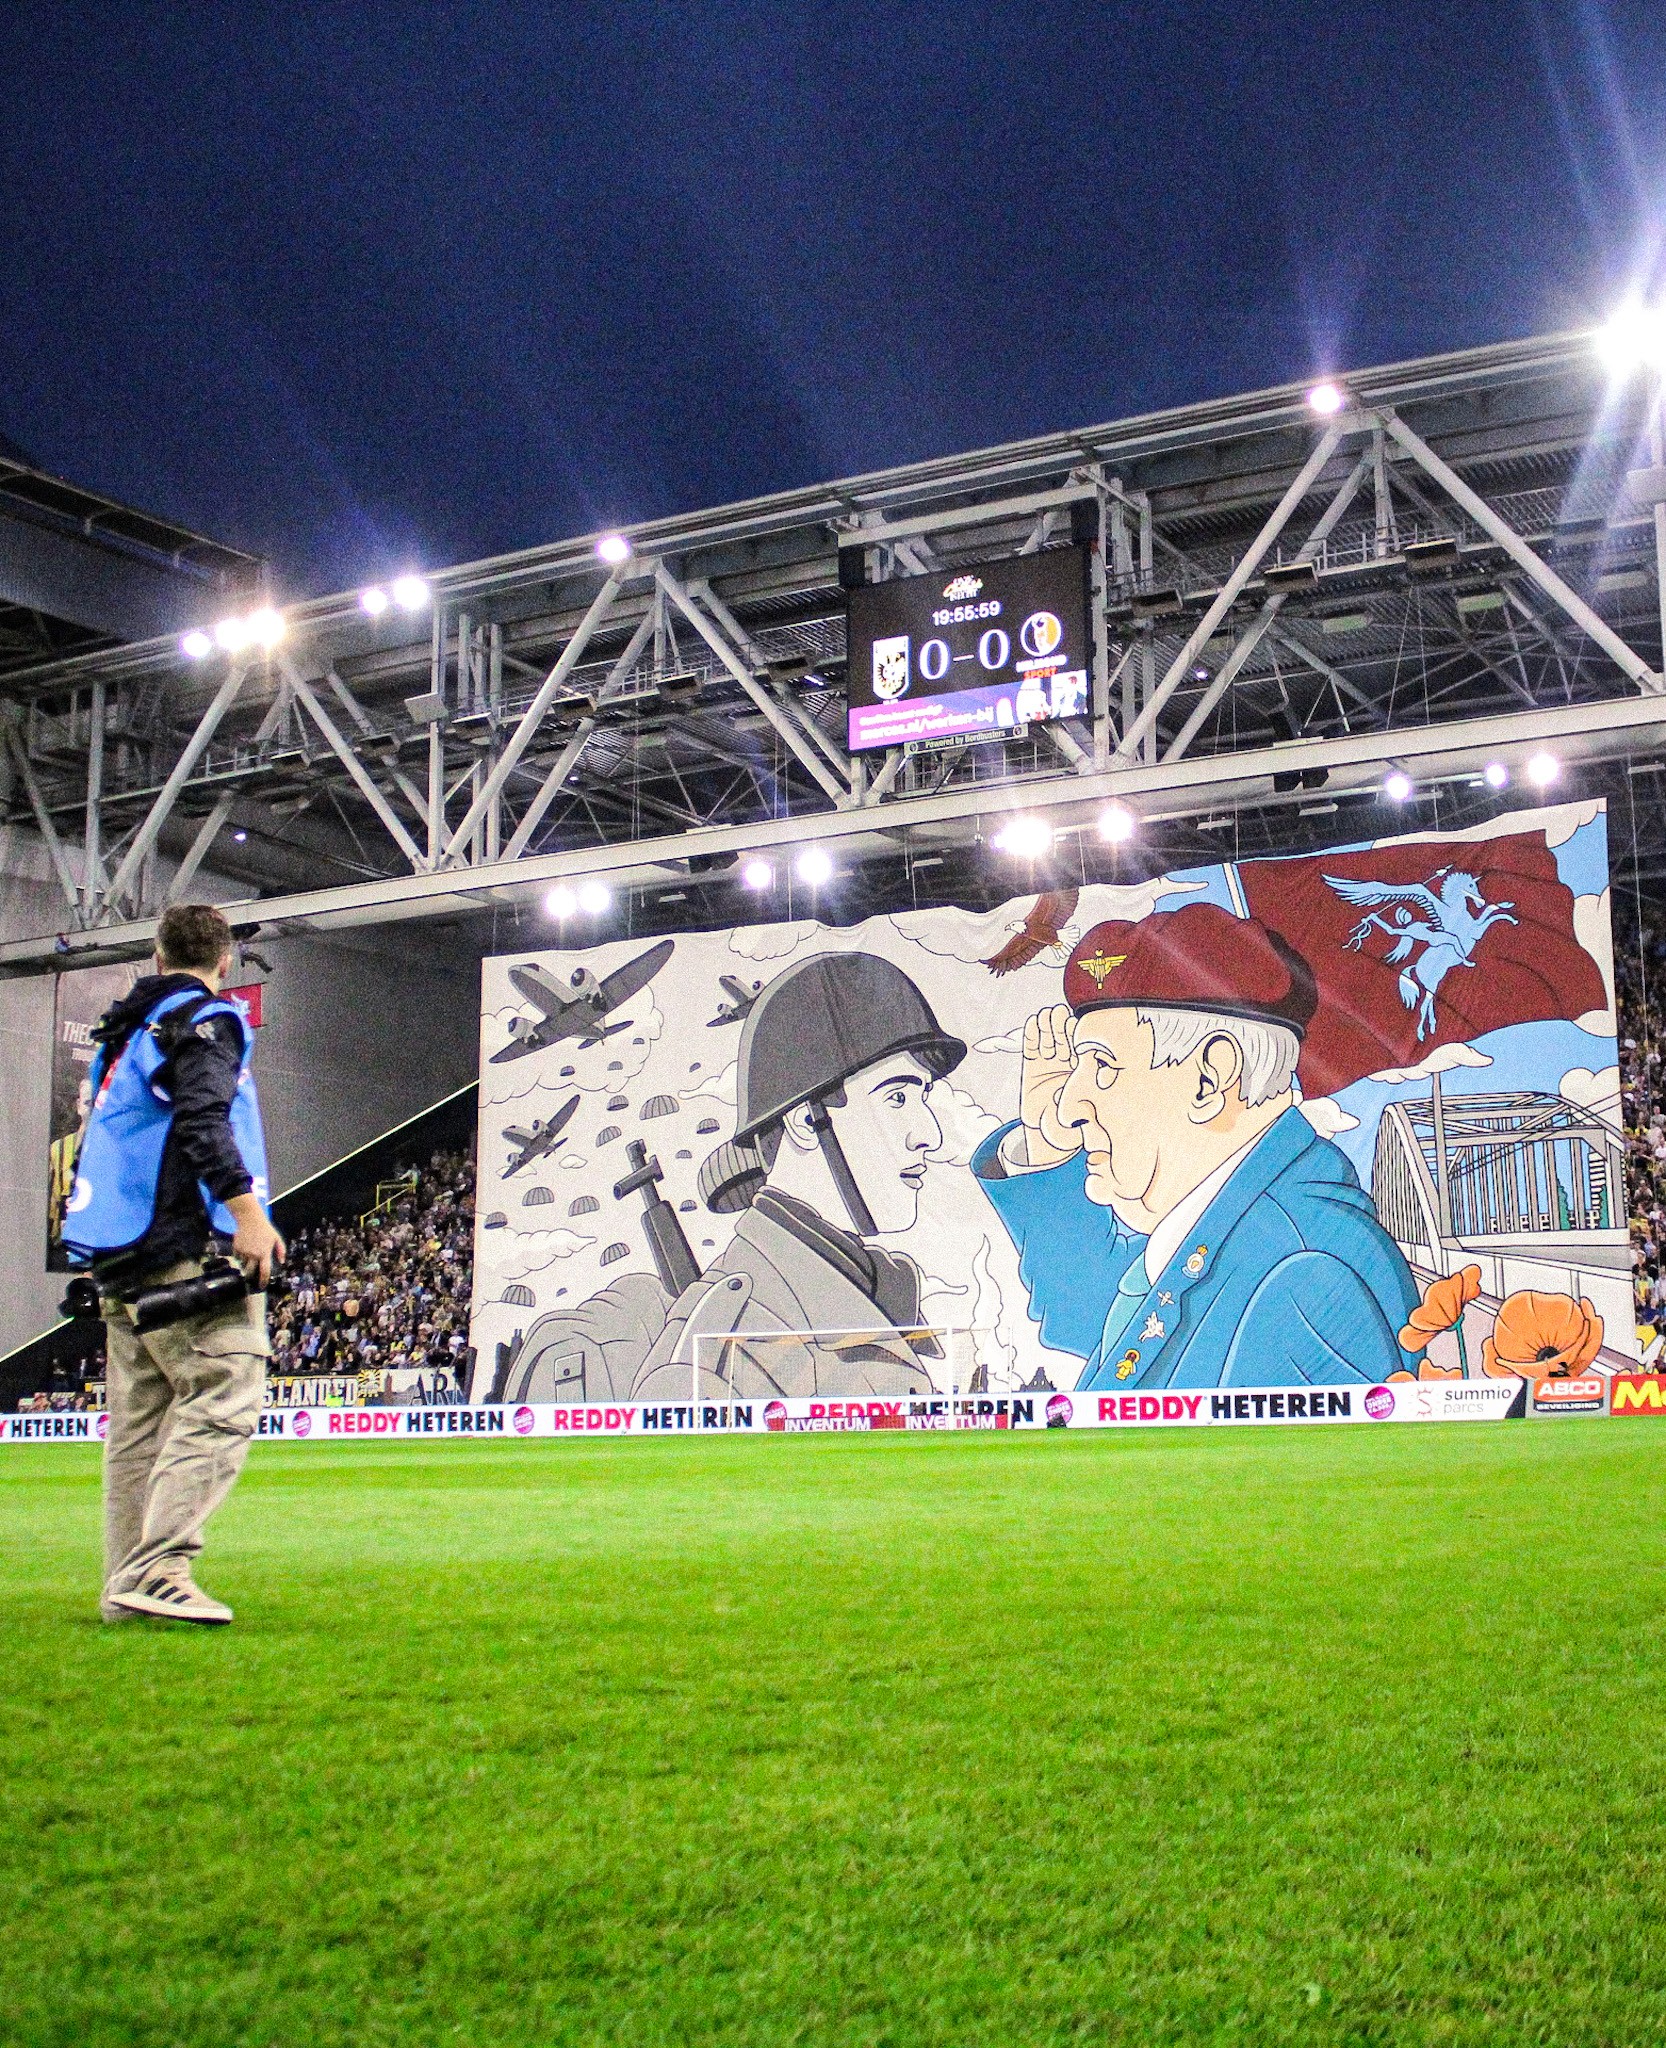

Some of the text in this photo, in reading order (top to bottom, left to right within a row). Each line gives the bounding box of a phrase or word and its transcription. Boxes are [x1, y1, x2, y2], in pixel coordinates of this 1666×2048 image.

[932, 600, 1001, 626] 19:55:59
[919, 639, 949, 680] 0
[979, 629, 1010, 670] 0
[1023, 667, 1057, 679] SPORT
[925, 737, 954, 748] Powered
[955, 736, 963, 744] by
[1445, 1386, 1511, 1401] summio
[1098, 1395, 1203, 1421] REDDY
[1211, 1391, 1351, 1419] HETEREN
[1444, 1402, 1484, 1415] parcs
[12, 1418, 88, 1438] HETEREN
[329, 1411, 401, 1433] REDDY
[407, 1410, 504, 1432] HETEREN
[554, 1407, 637, 1430] REDDY
[785, 1416, 871, 1432] INVENTUM
